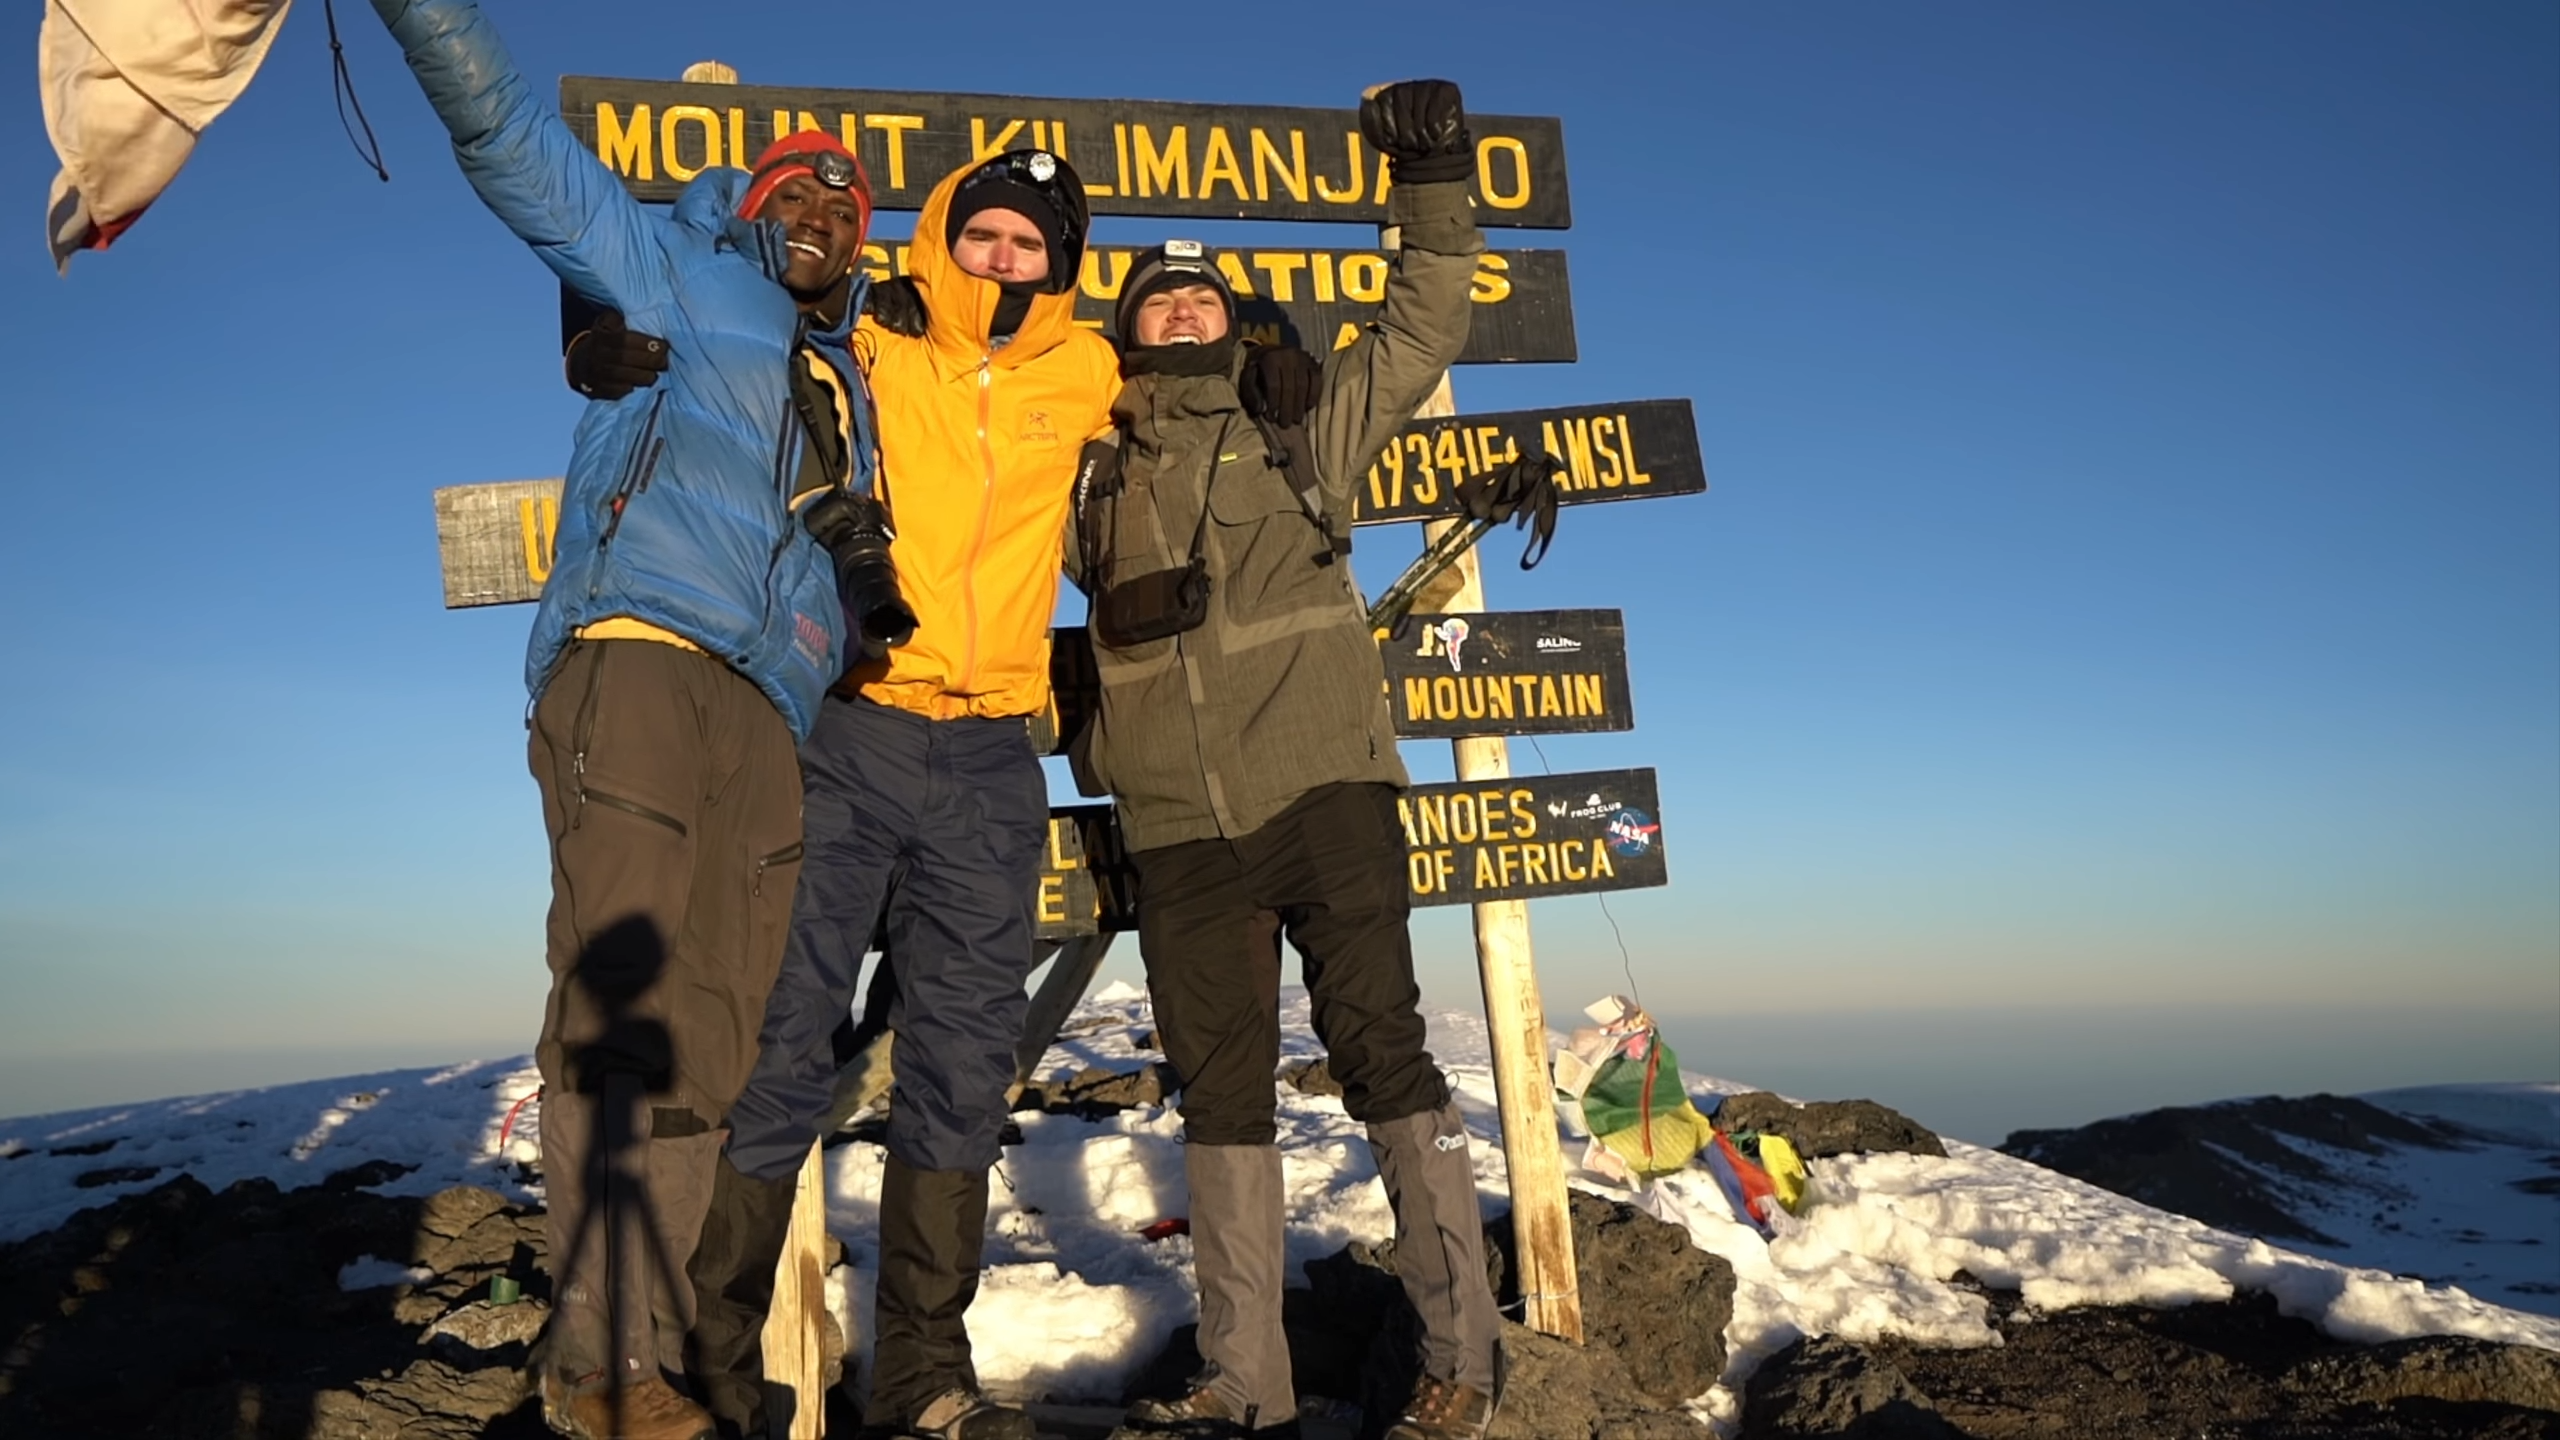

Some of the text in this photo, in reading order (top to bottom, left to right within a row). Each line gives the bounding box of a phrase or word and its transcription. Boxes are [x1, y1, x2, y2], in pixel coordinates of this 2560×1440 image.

[1542, 415, 1651, 491] AMSL
[1405, 674, 1603, 721] MOUNTAIN
[1397, 789, 1537, 847] ANOES
[1597, 802, 1622, 813] CLUB
[1610, 820, 1650, 846] NASA
[1409, 850, 1453, 894] OF
[1475, 839, 1614, 889] AFRICA
